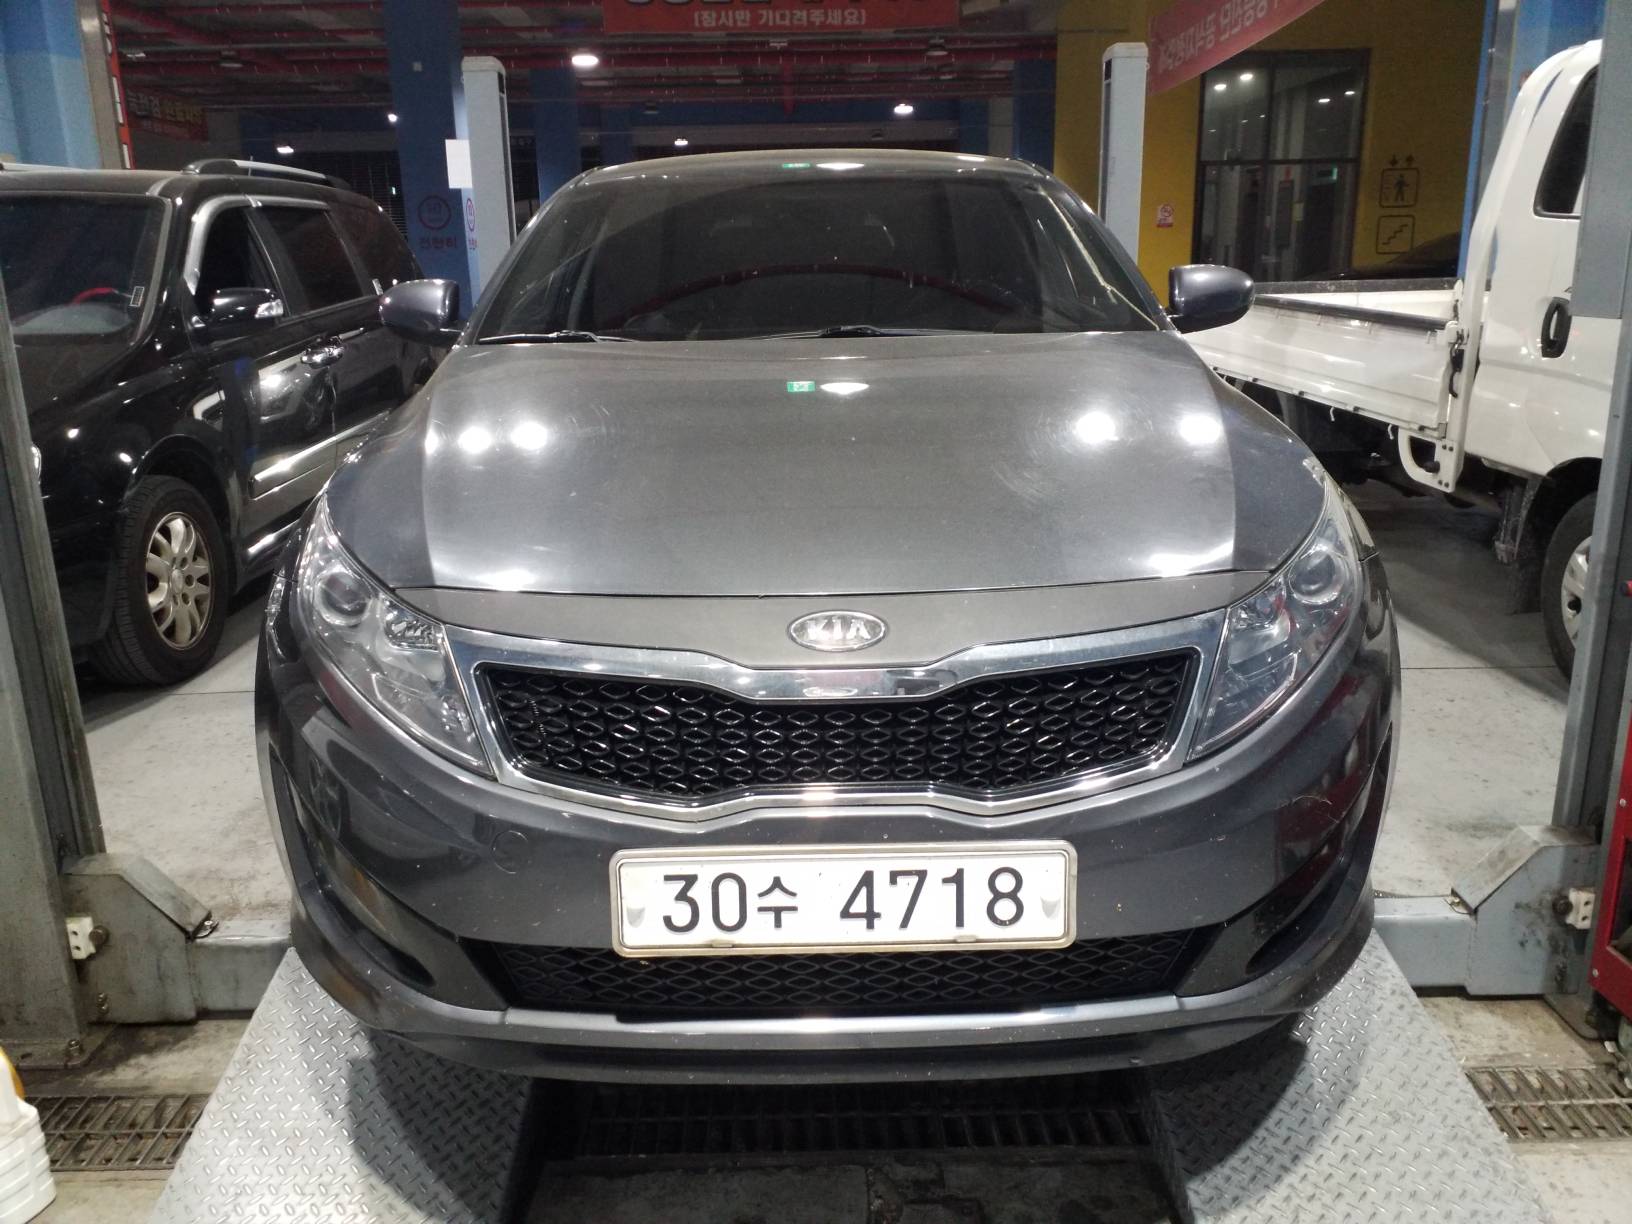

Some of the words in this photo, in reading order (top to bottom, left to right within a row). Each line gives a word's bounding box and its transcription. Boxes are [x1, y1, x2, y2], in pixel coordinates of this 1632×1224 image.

[694, 9, 750, 28] [잠시만
[758, 8, 866, 27] 기다려주세요]
[807, 616, 871, 640] KIA
[661, 872, 799, 933] 30수
[839, 866, 1025, 931] 4718
